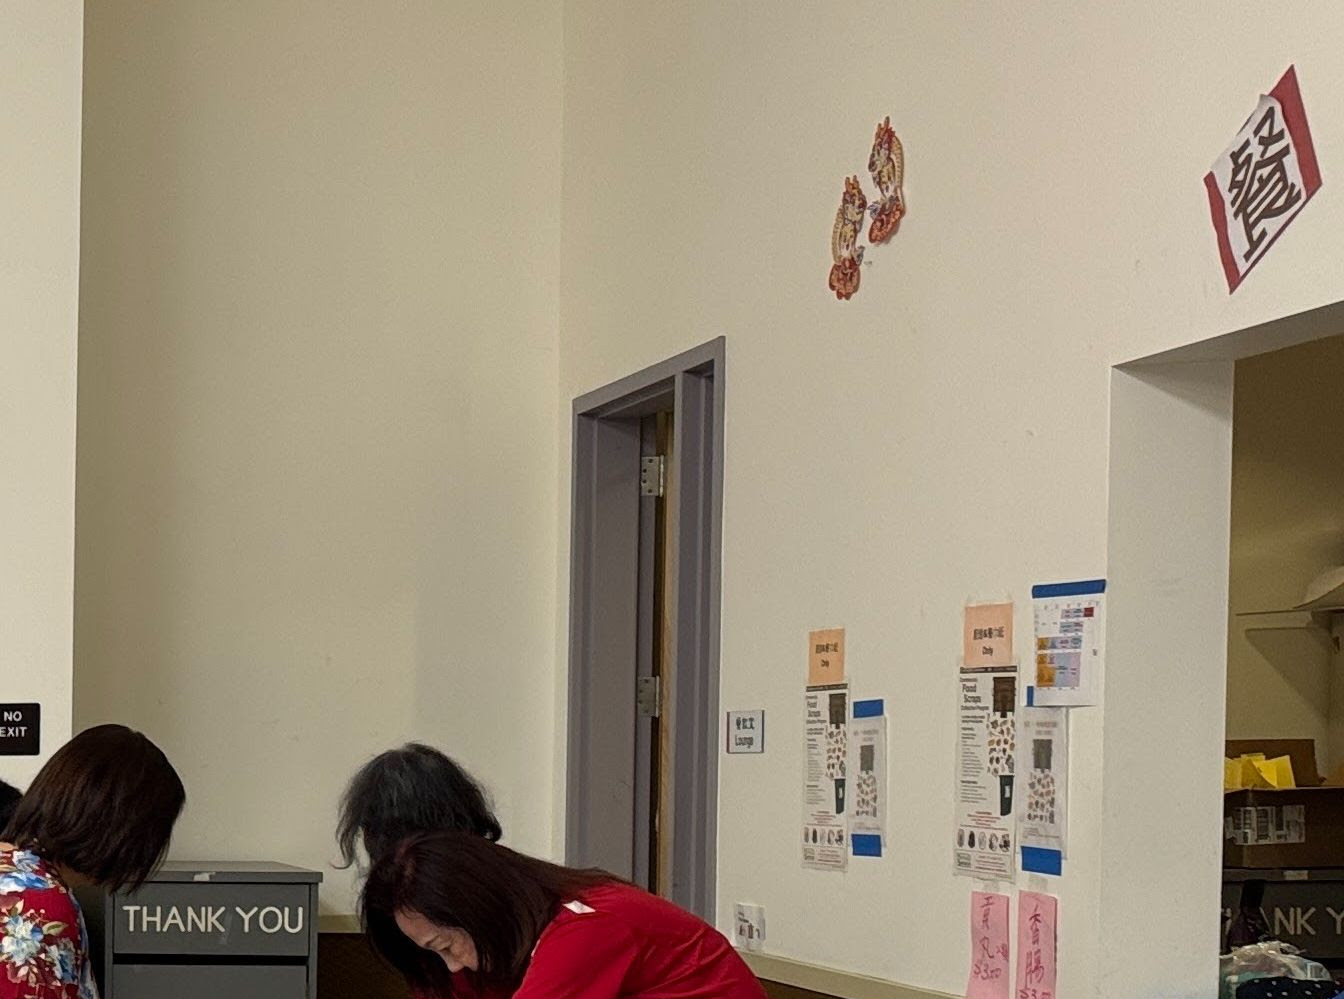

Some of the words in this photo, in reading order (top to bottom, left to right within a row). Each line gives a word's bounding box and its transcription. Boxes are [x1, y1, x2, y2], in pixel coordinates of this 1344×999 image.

[3, 711, 23, 722] NO
[122, 905, 226, 933] THANK
[235, 906, 304, 934] YOU
